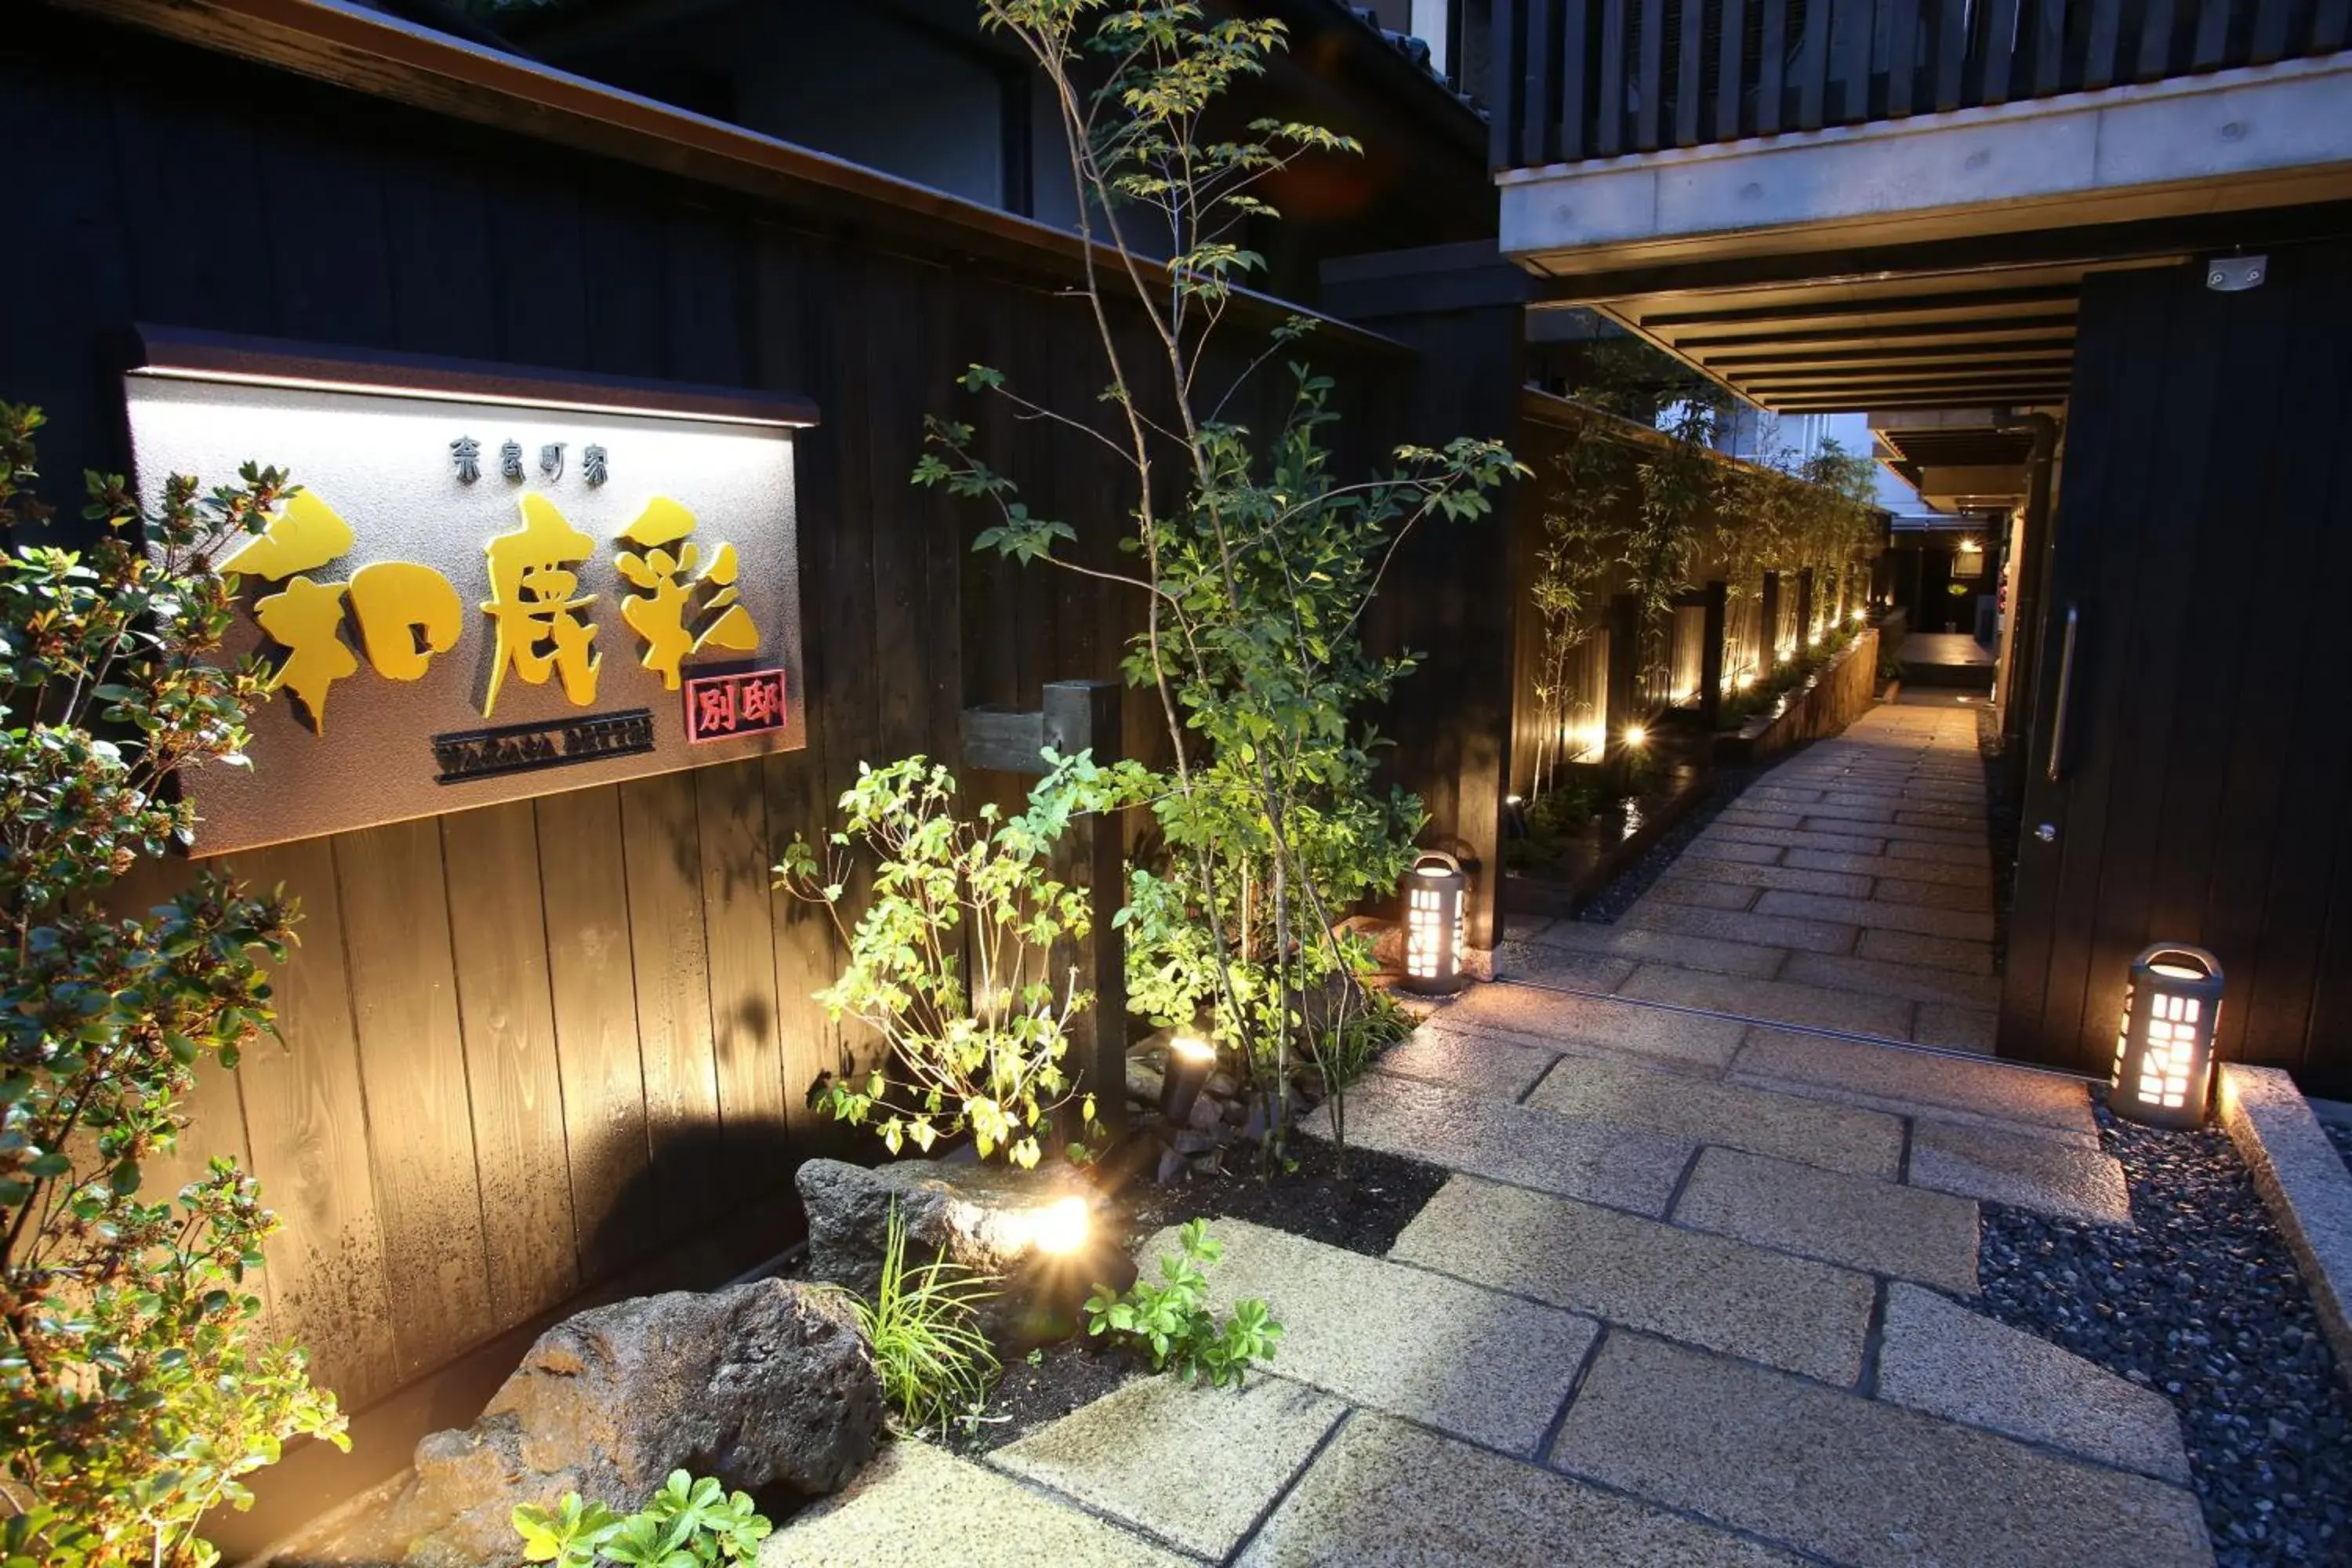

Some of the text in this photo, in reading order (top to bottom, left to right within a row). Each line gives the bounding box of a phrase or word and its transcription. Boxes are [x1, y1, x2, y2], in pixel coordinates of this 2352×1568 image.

[449, 434, 609, 485] 奈良町家
[216, 488, 760, 736] 和鹿彩
[698, 679, 779, 731] 別邸
